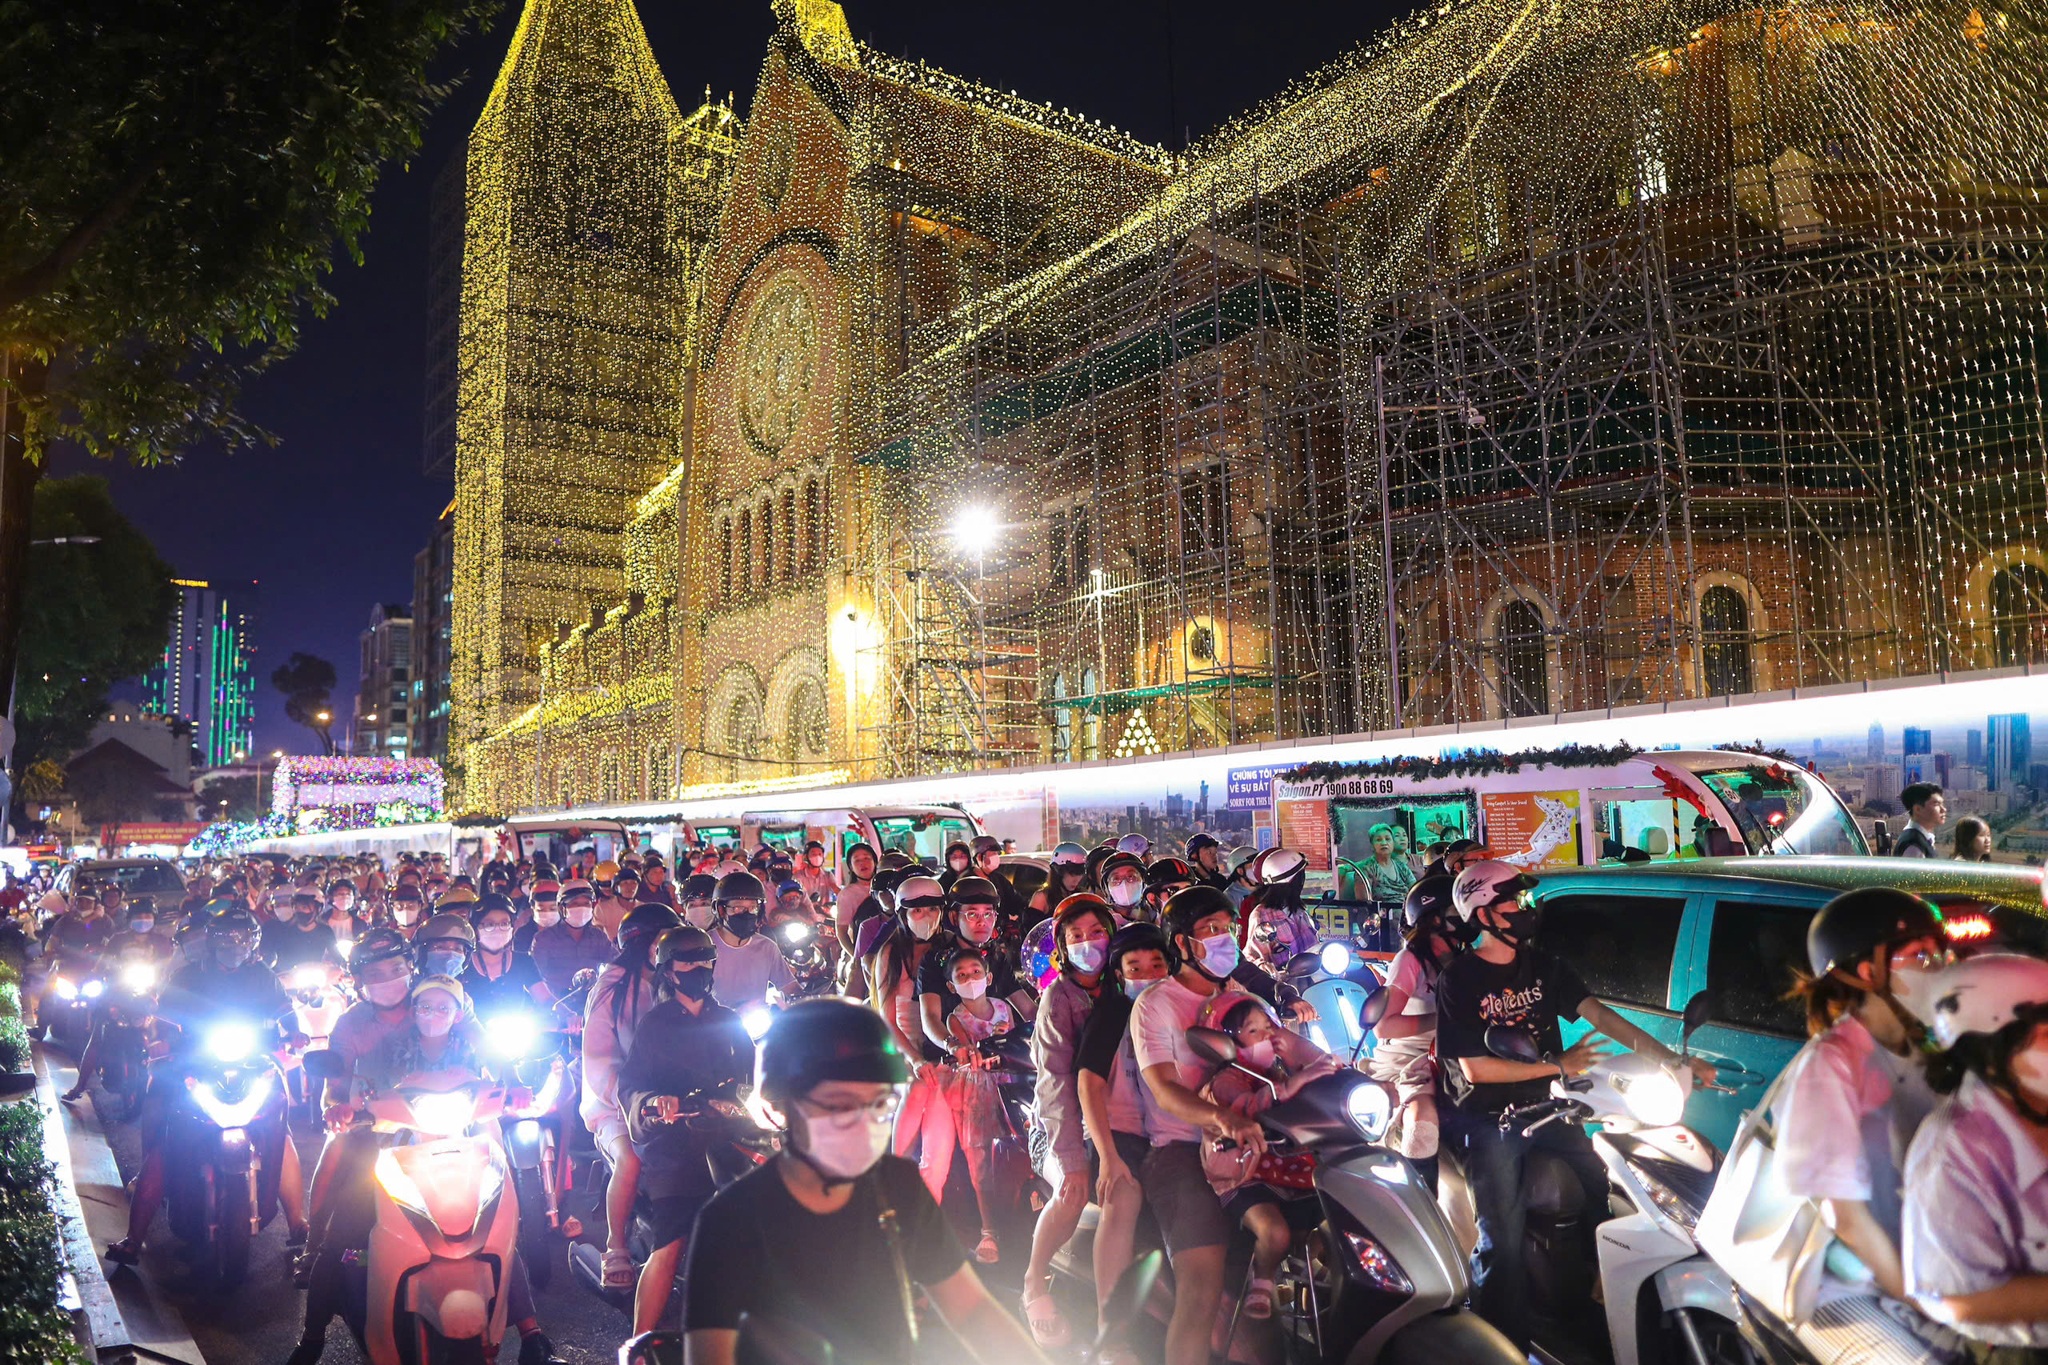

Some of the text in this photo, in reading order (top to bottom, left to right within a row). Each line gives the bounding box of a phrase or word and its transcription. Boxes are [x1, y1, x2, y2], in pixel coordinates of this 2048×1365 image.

[1232, 769, 1257, 781] CHÚNG
[1259, 768, 1272, 779] TÔI
[1326, 783, 1347, 796] 1900
[1348, 781, 1361, 795] 88
[1364, 780, 1377, 794] 68
[1379, 780, 1393, 793] 69
[1229, 798, 1245, 808] SORRY
[1246, 798, 1255, 807] FOR
[1255, 797, 1267, 806] THIS
[1602, 1234, 1631, 1251] HONDA
